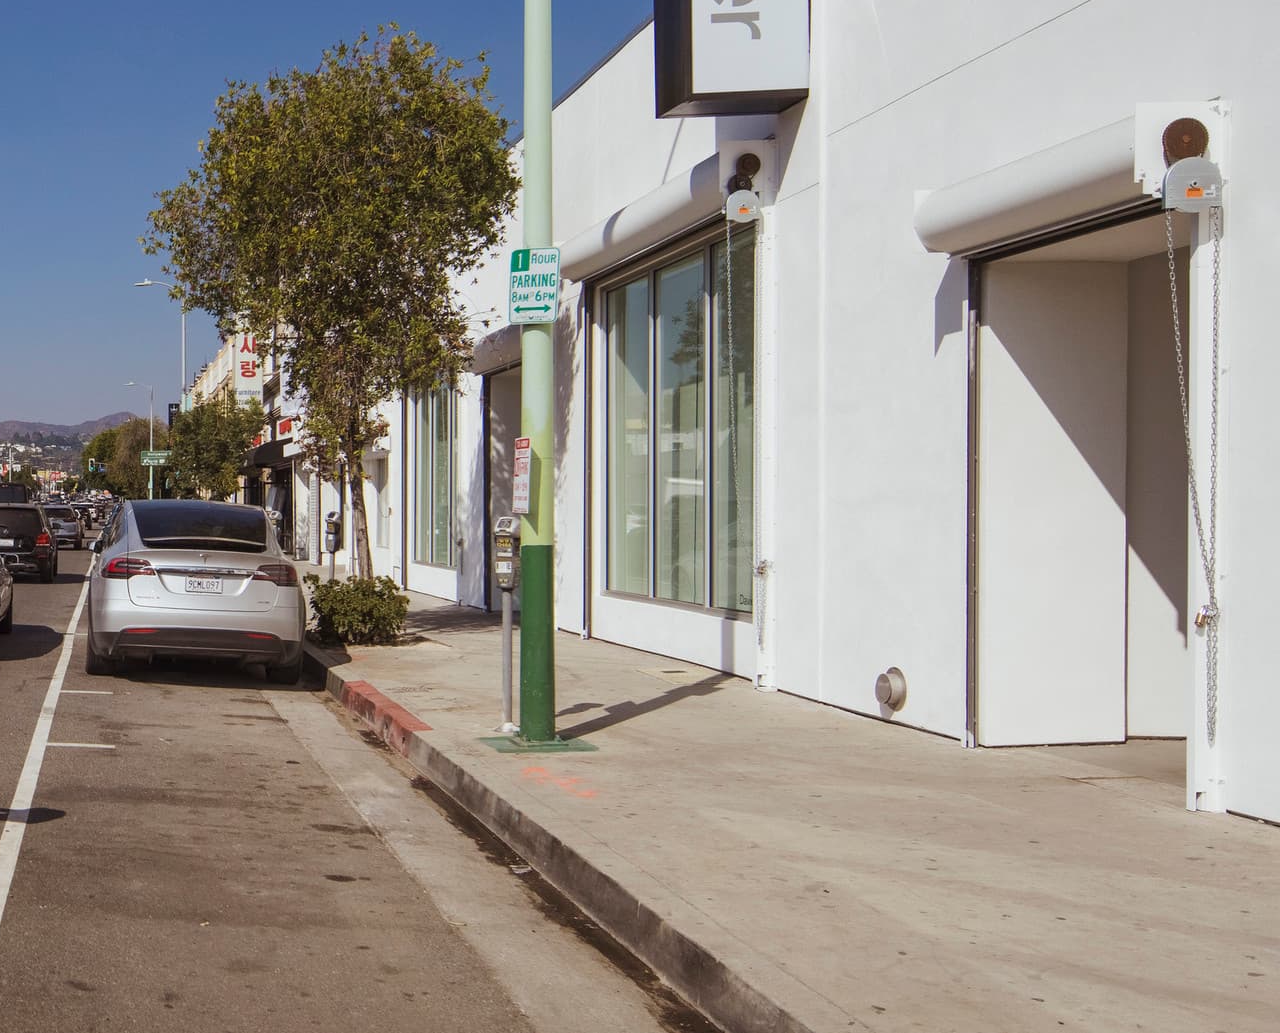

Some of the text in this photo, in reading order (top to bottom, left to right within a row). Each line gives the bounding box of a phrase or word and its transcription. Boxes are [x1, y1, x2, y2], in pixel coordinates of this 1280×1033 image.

[511, 273, 556, 288] PARKING
[512, 292, 529, 303] 8AM
[535, 290, 555, 302] 6PM
[188, 580, 220, 590] 9CML097
